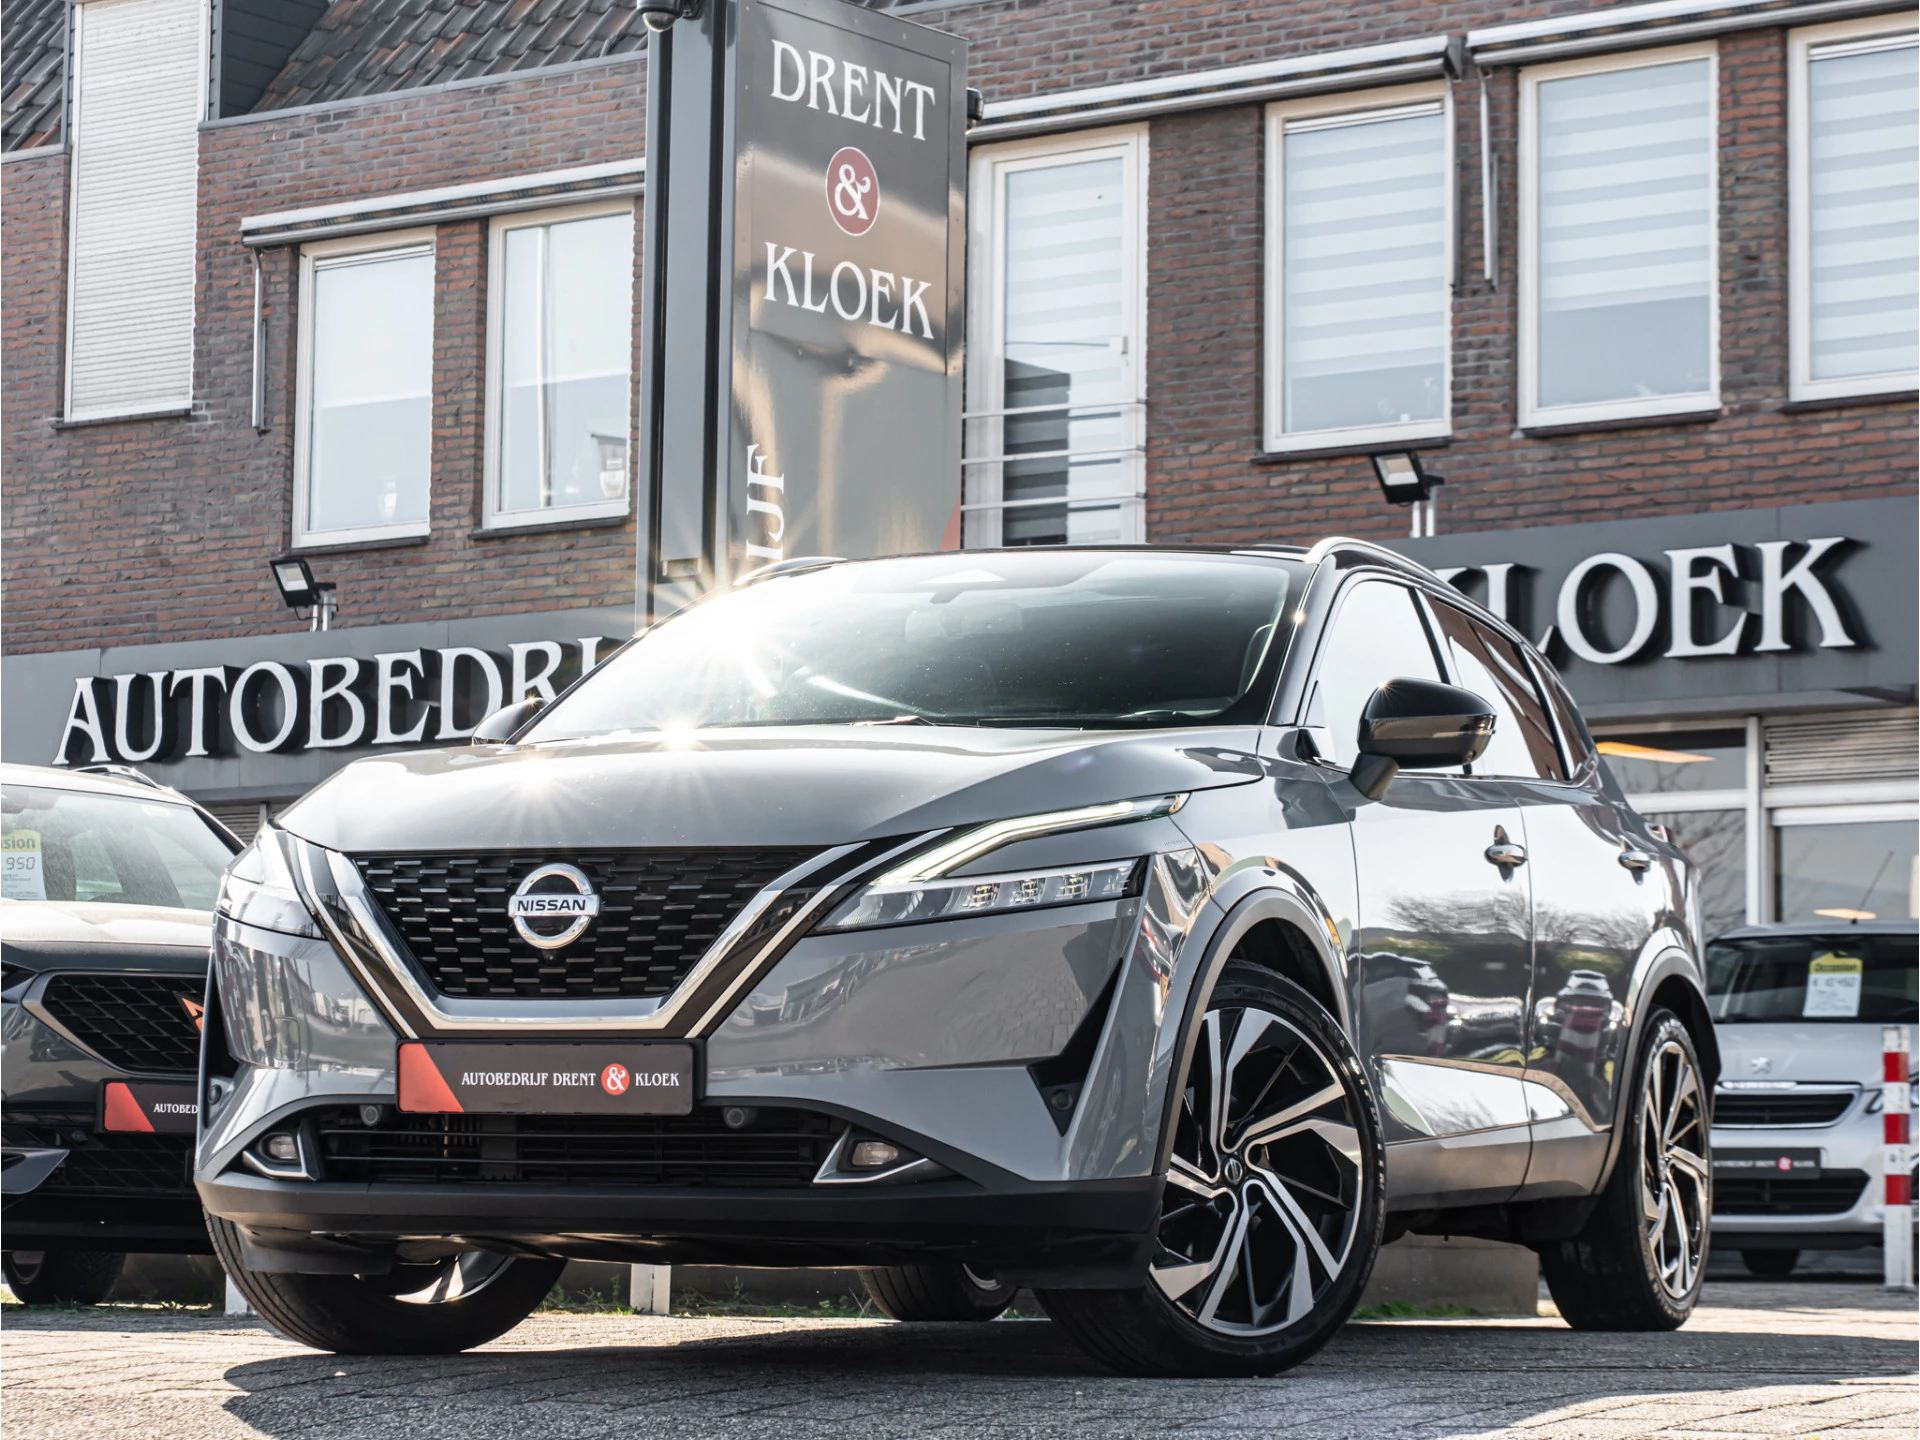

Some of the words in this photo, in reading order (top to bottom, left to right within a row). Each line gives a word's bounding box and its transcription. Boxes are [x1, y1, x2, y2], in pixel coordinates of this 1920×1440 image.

[770, 38, 936, 142] DRENT
[834, 163, 872, 221] &
[763, 241, 935, 340] KLOEK
[1, 835, 37, 849] sion
[517, 899, 586, 912] NISSAN
[461, 1072, 549, 1086] AUTOBEDRIJF
[552, 1072, 597, 1087] DRENT
[606, 1066, 627, 1091] &
[635, 1072, 680, 1087] KLOEK
